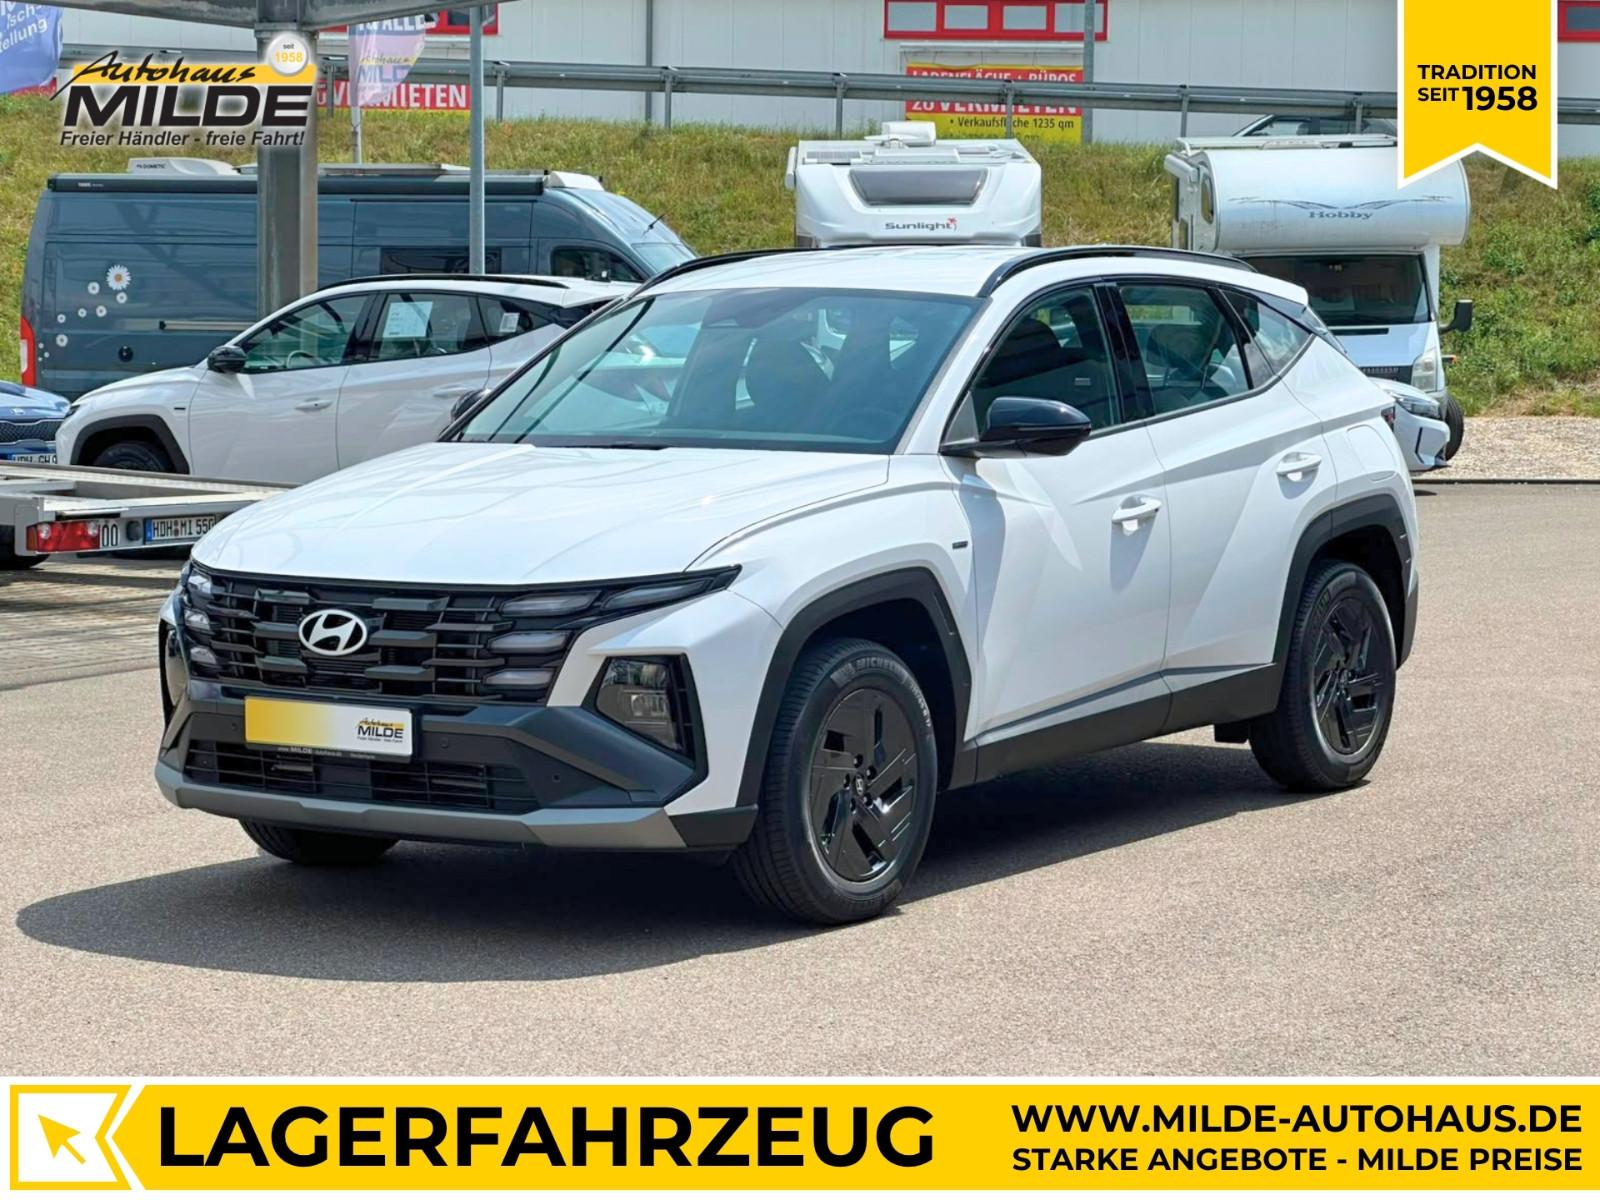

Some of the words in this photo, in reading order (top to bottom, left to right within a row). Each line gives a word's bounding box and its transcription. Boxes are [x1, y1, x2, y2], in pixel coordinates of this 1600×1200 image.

[1033, 118, 1055, 128] 1235
[1058, 120, 1074, 131] qm
[1309, 211, 1373, 220] Hobby
[885, 221, 954, 231] Sunlight
[153, 519, 173, 537] HDH
[358, 725, 405, 739] MILDE
